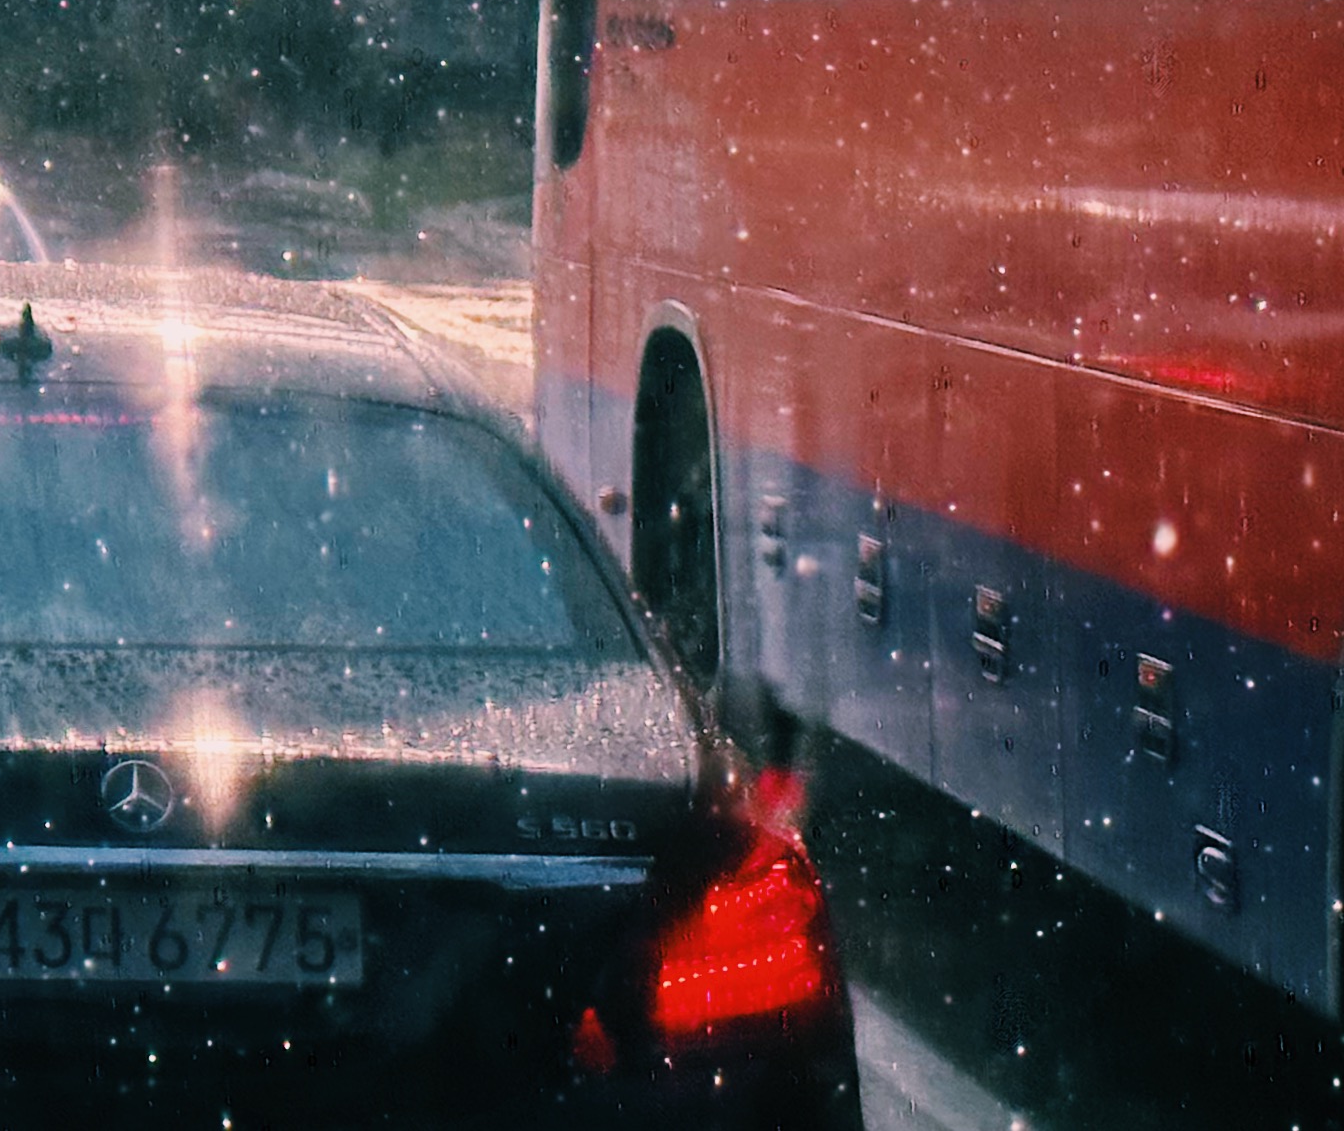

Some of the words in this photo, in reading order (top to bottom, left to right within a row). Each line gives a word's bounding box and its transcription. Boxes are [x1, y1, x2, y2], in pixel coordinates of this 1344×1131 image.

[516, 817, 542, 840] S
[551, 816, 637, 841] 560
[147, 901, 337, 974] 6775
